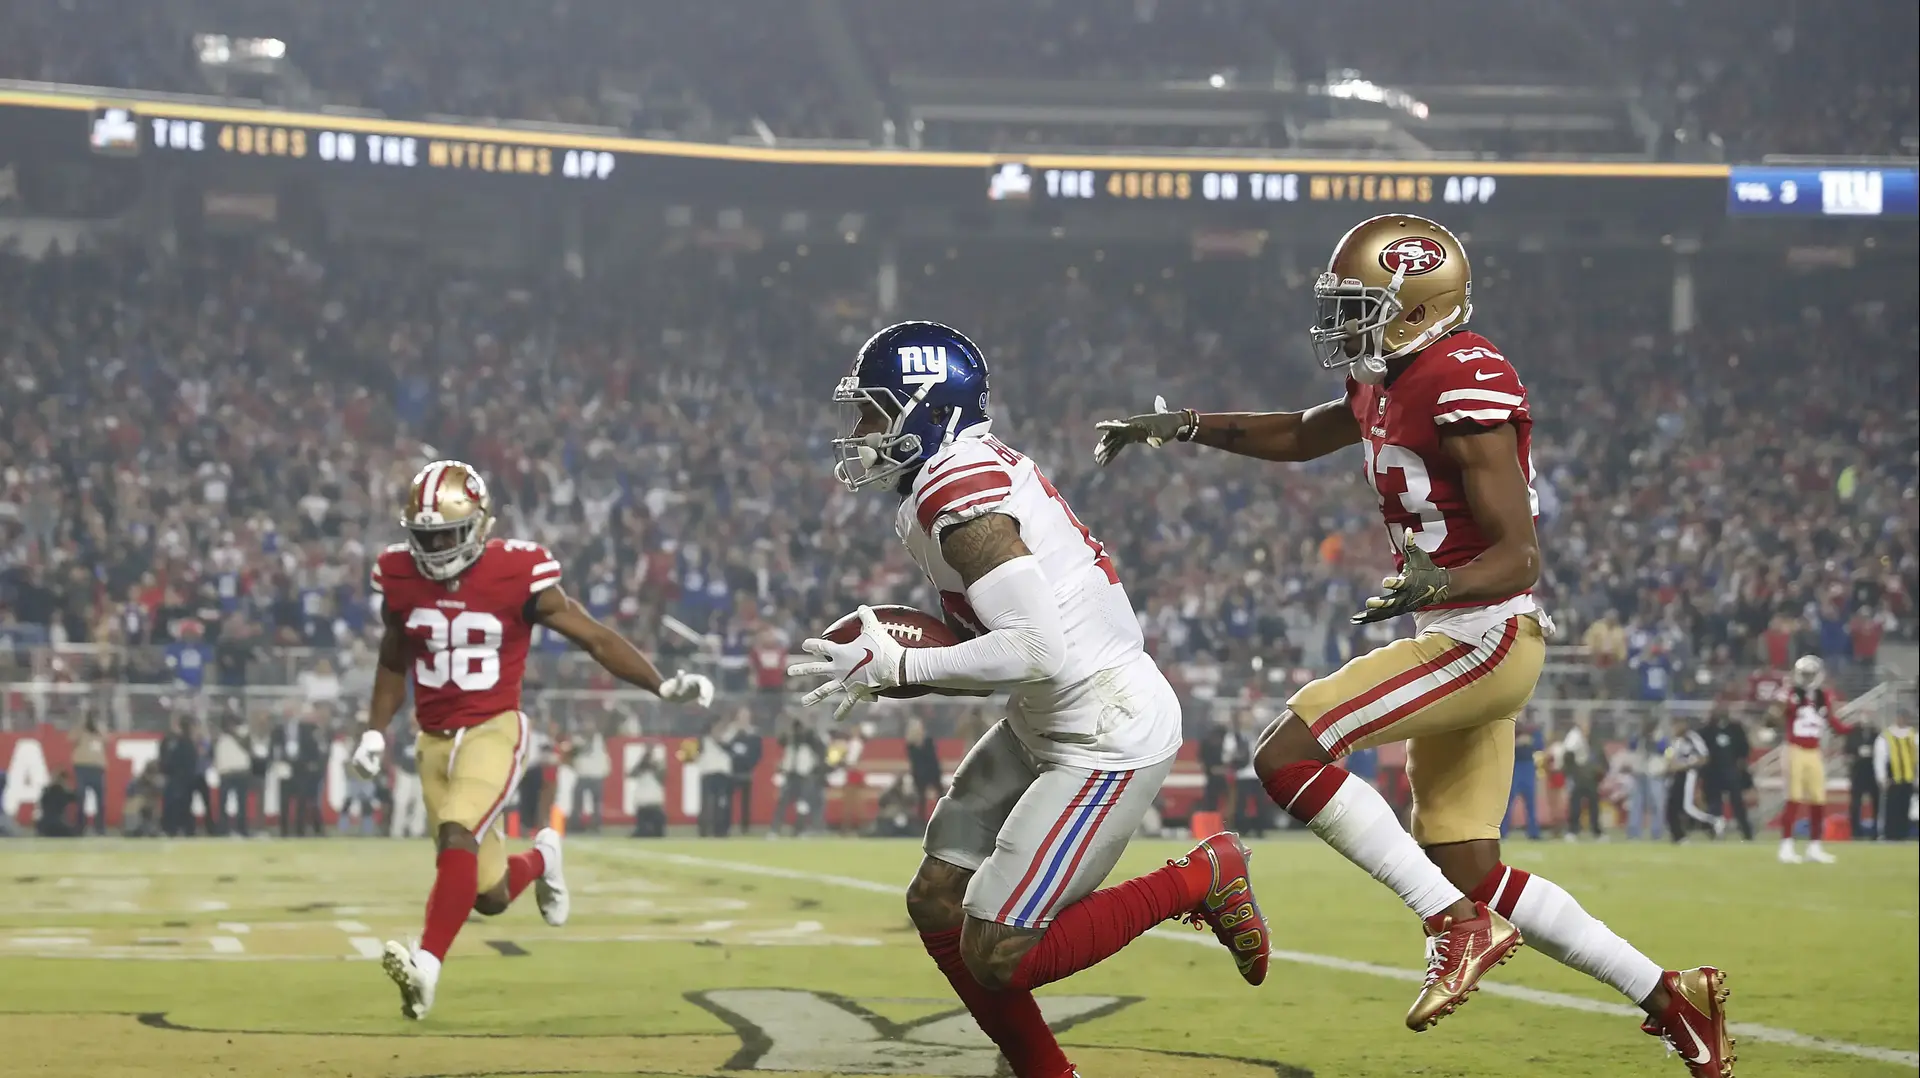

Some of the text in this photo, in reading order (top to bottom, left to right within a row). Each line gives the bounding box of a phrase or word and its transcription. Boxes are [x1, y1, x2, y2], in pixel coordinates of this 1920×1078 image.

[152, 118, 615, 180] THE 49ERS ON THE MYTEAMS APP
[1045, 169, 1496, 203] THE 49ERS ON THE MYTEAMS APP
[405, 607, 503, 692] 38
